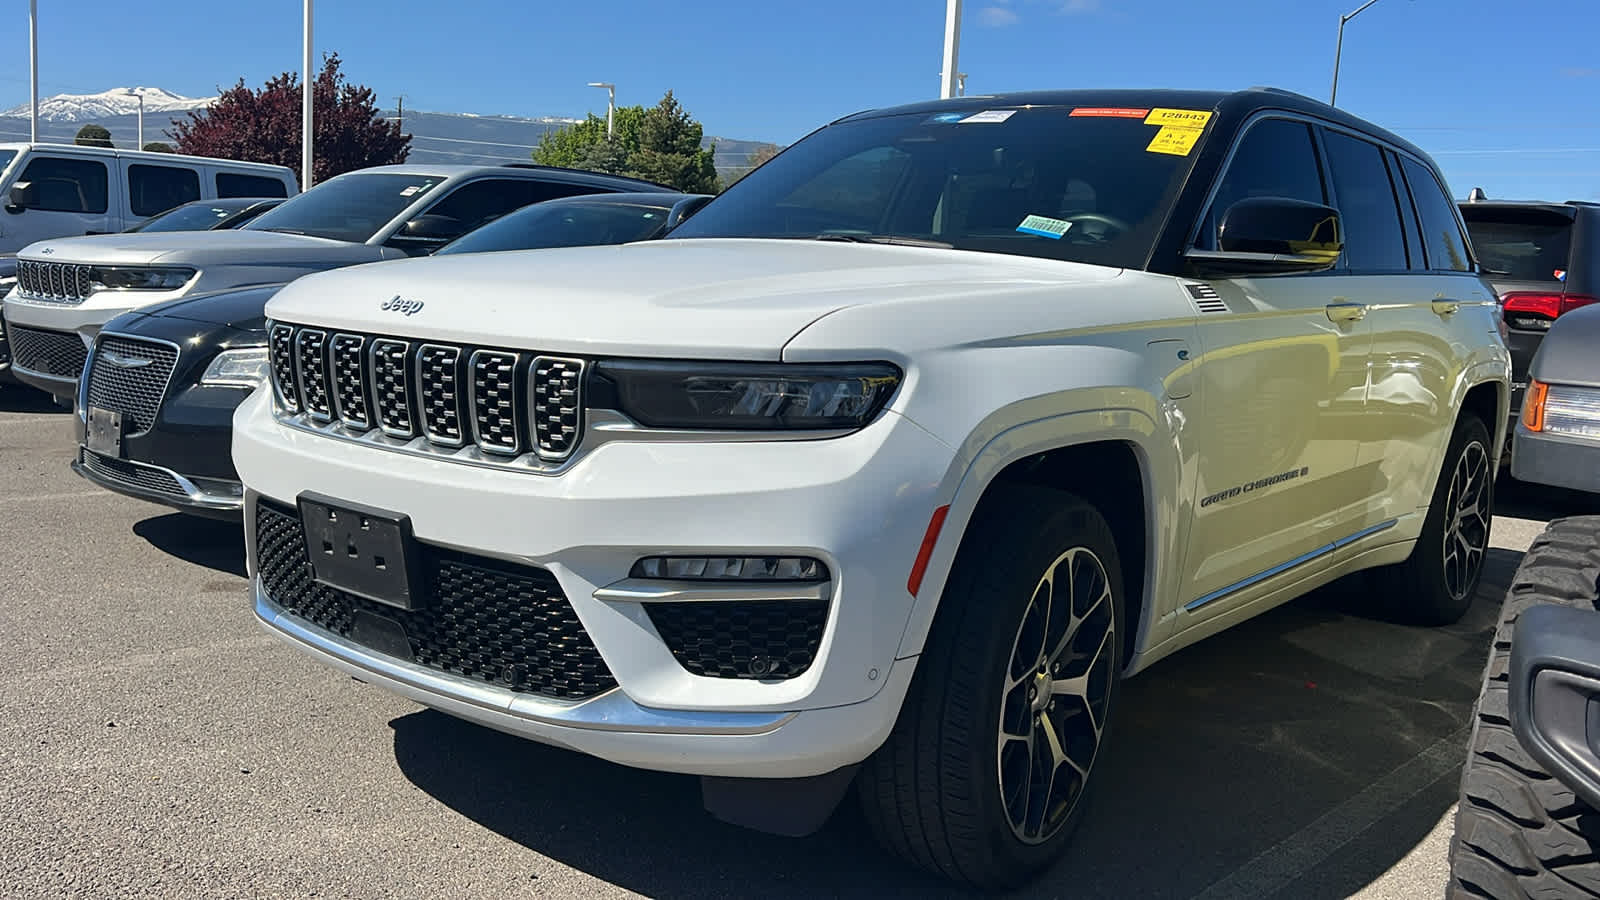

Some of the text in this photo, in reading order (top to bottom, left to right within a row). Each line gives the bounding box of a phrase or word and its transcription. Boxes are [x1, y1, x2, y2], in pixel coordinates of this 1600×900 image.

[380, 295, 425, 317] Jeep
[1200, 469, 1299, 508] GRAND CHEROKEE
